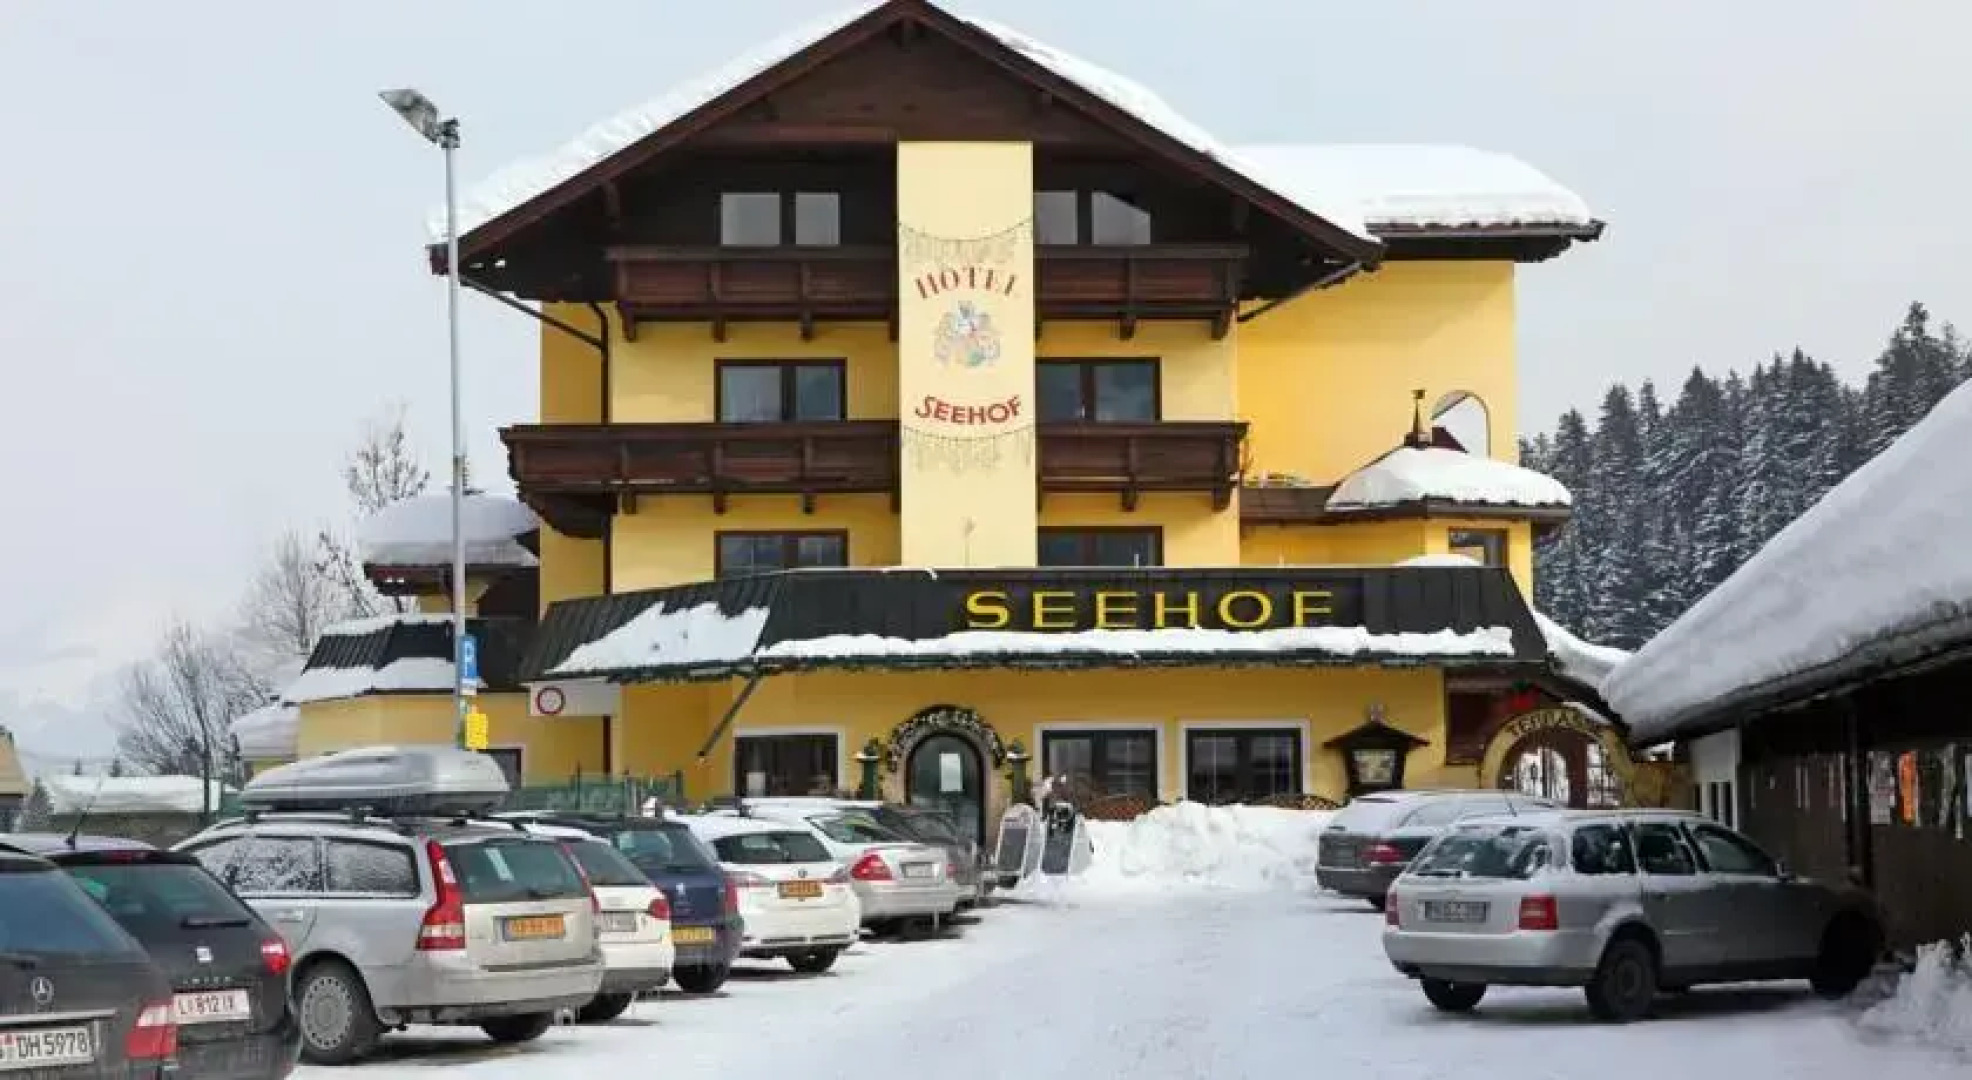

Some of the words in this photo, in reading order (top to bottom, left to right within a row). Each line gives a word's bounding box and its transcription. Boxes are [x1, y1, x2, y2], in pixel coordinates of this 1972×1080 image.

[914, 266, 1018, 298] HOTEL
[914, 394, 1021, 425] SEEHOF
[966, 591, 1333, 628] SEEHOF
